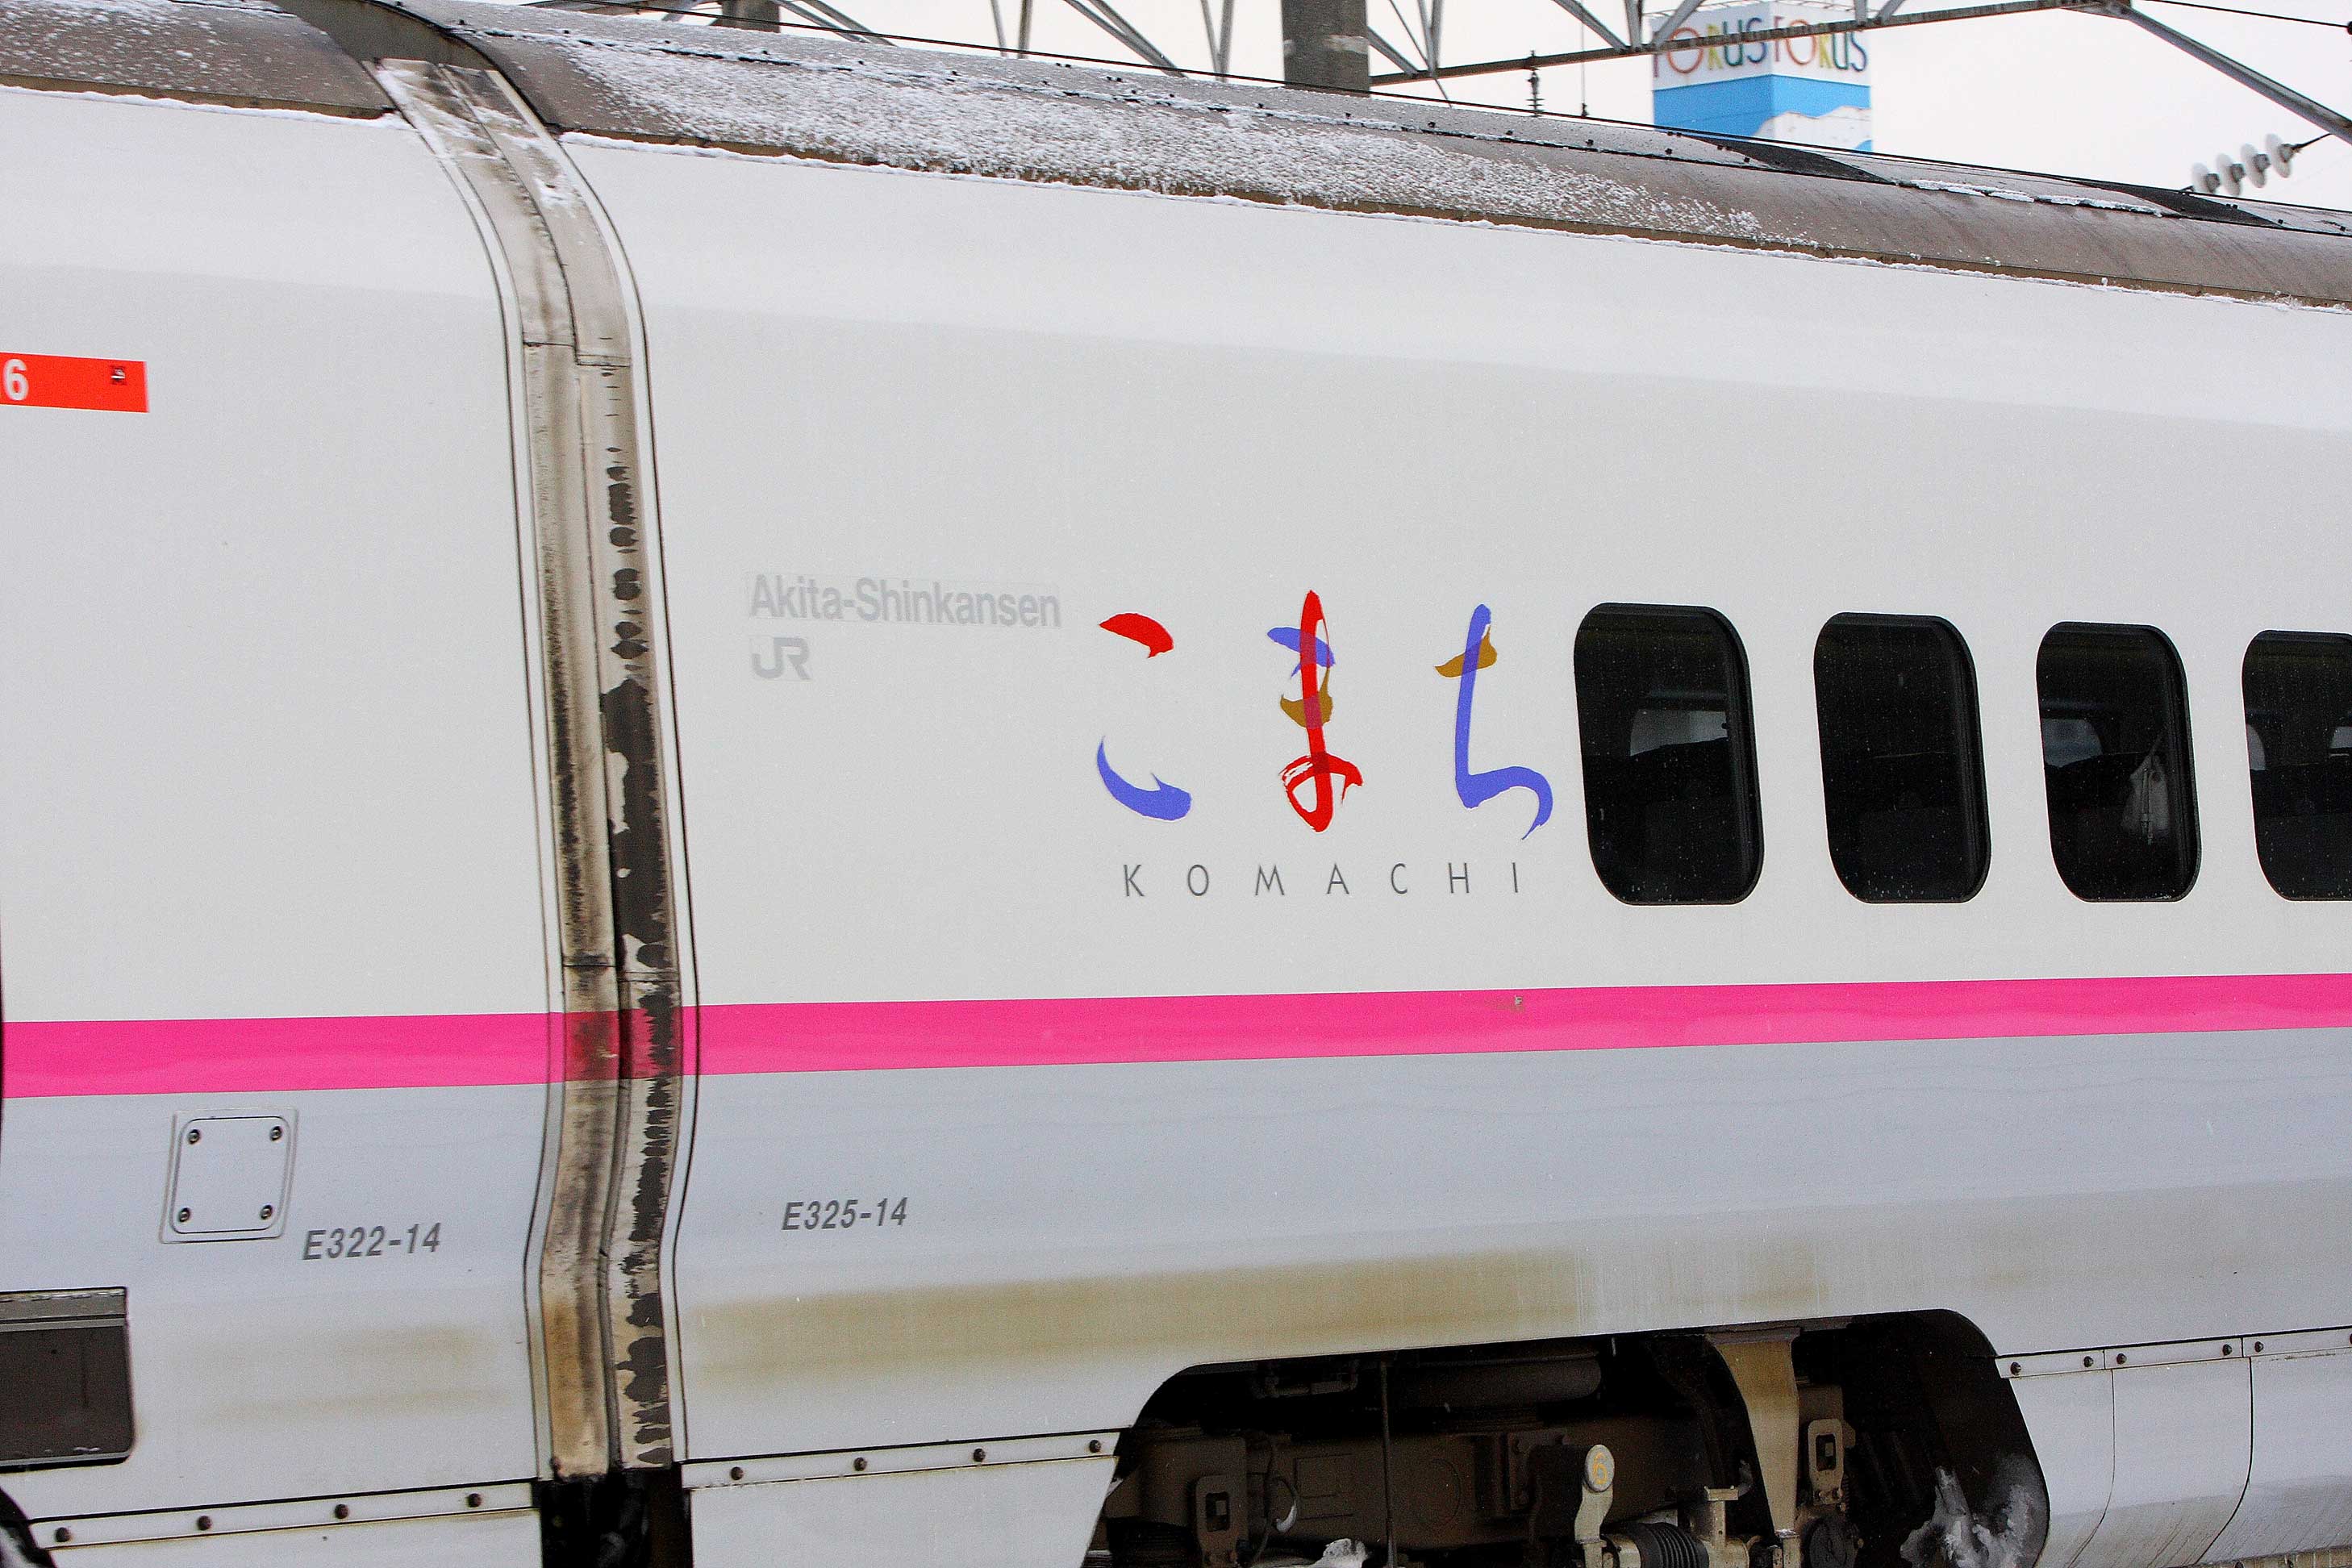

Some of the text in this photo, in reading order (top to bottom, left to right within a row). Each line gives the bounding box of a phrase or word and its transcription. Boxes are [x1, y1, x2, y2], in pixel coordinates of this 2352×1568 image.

[2, 358, 29, 401] 6
[751, 573, 1061, 627] Akita-Shinkansen
[751, 637, 811, 681] JR
[1097, 590, 1553, 840] こまち
[1124, 862, 1520, 897] KOMACHI
[782, 1197, 908, 1230] E325-14
[303, 1223, 440, 1260] E322-14
[1592, 1453, 1608, 1484] 6
